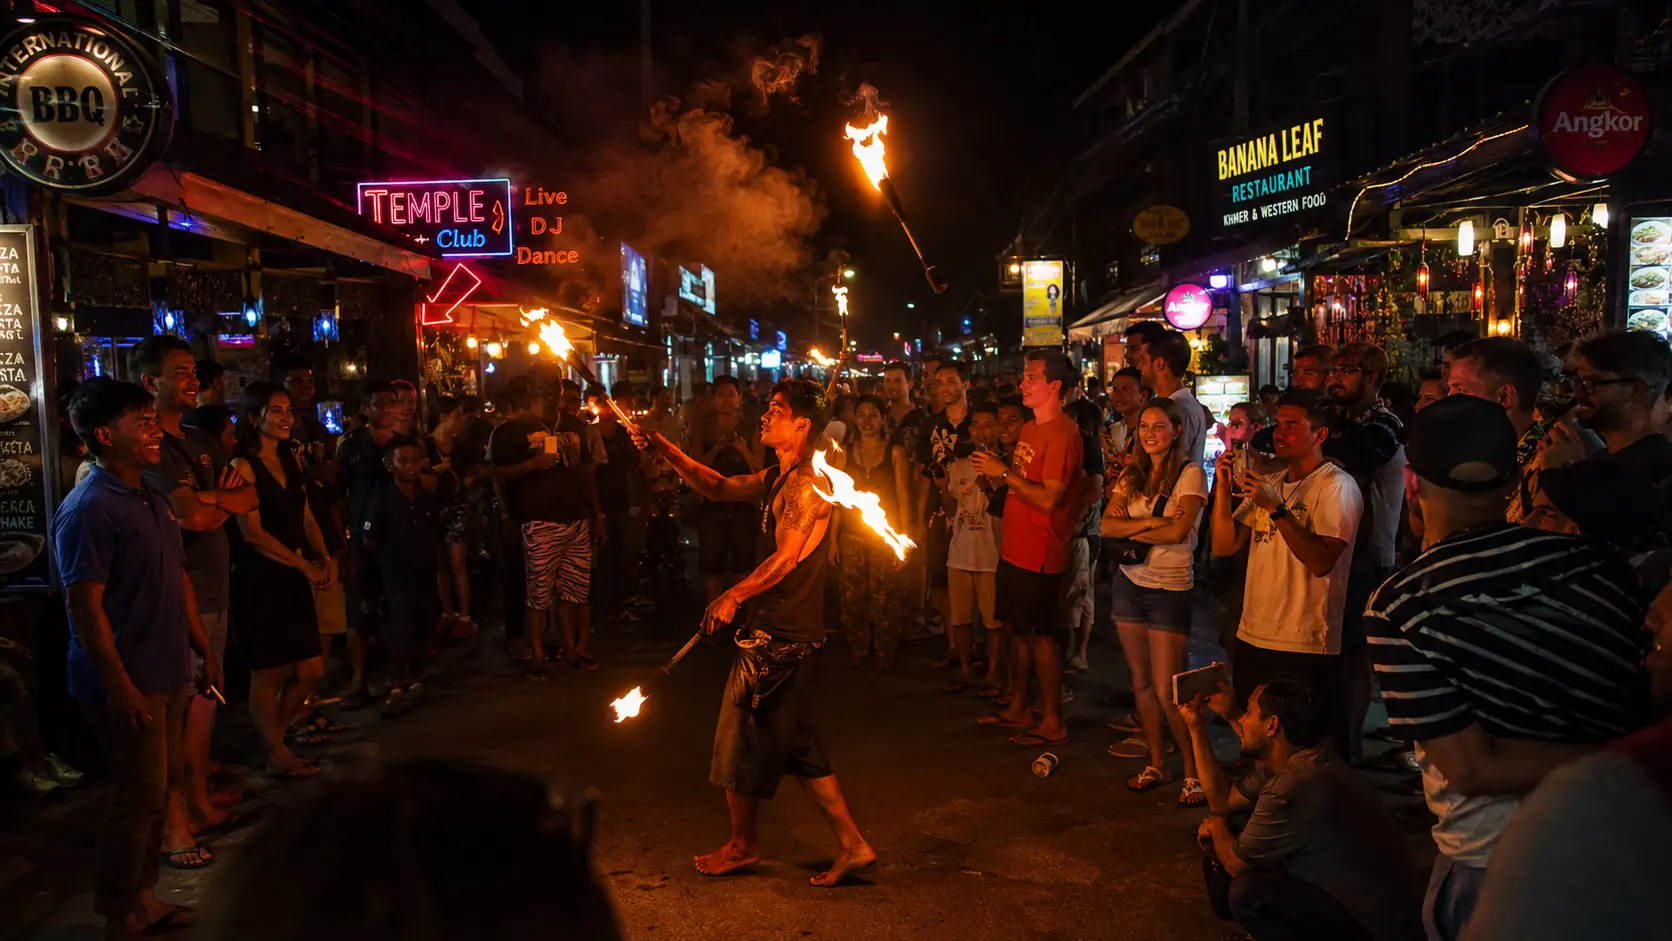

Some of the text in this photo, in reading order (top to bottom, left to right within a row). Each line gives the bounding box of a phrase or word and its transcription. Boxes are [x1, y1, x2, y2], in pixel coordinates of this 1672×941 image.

[29, 85, 105, 126] BBQ
[1552, 110, 1645, 139] Angkor
[1217, 117, 1324, 181] BANANA LEAF
[524, 187, 568, 206] Live
[1232, 165, 1312, 203] RESTAURANT
[364, 189, 485, 225] TEMPLE
[1252, 208, 1259, 221] &
[1260, 199, 1299, 219] WESTERN
[1301, 192, 1327, 211] FOOD
[436, 228, 487, 249] Club
[517, 246, 579, 265] Dance
